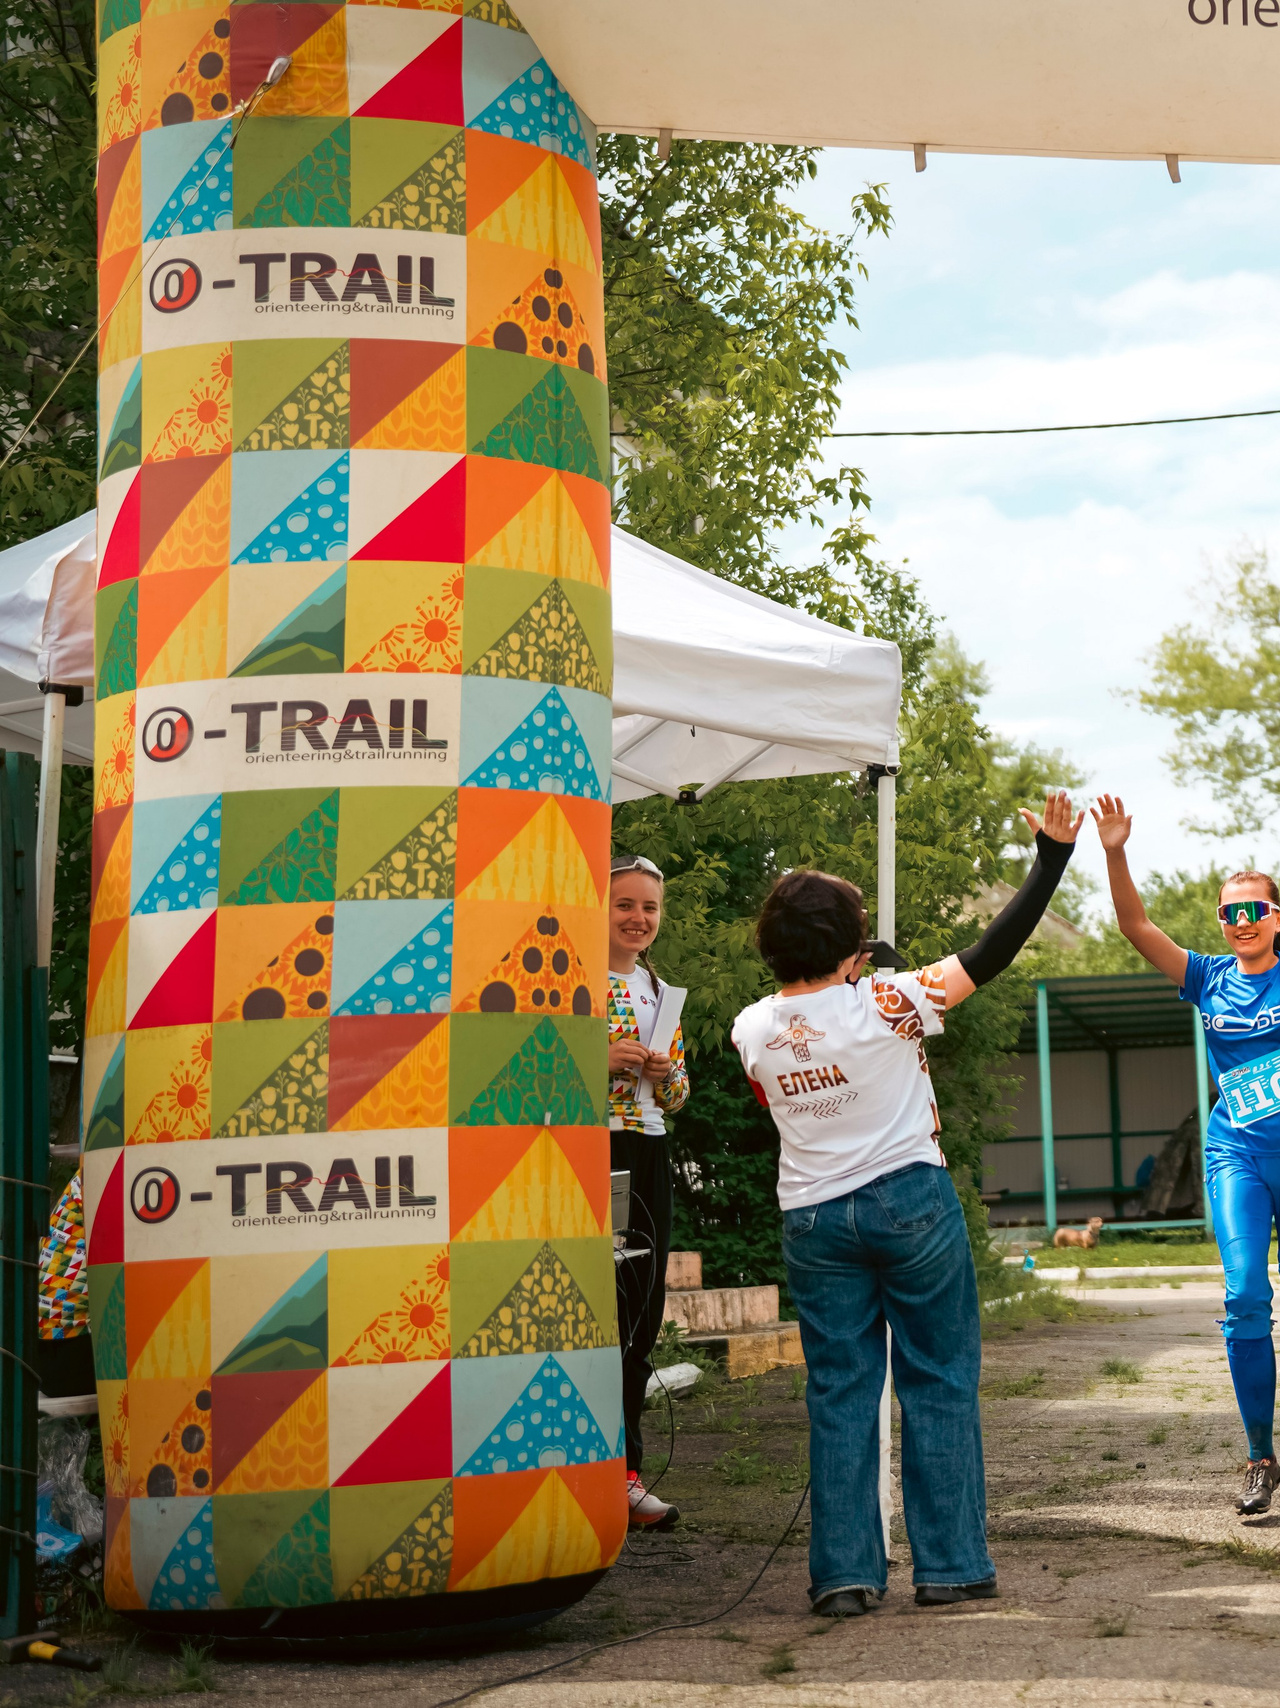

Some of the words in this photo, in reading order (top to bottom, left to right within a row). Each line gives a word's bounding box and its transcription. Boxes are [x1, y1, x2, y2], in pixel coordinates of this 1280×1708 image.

[255, 301, 455, 320] orienteering&trailrunning
[245, 748, 448, 764] orienteering&trailrunning
[777, 1064, 849, 1097] ЕЛЕНА
[232, 1205, 437, 1228] orienteering&trailrunning
